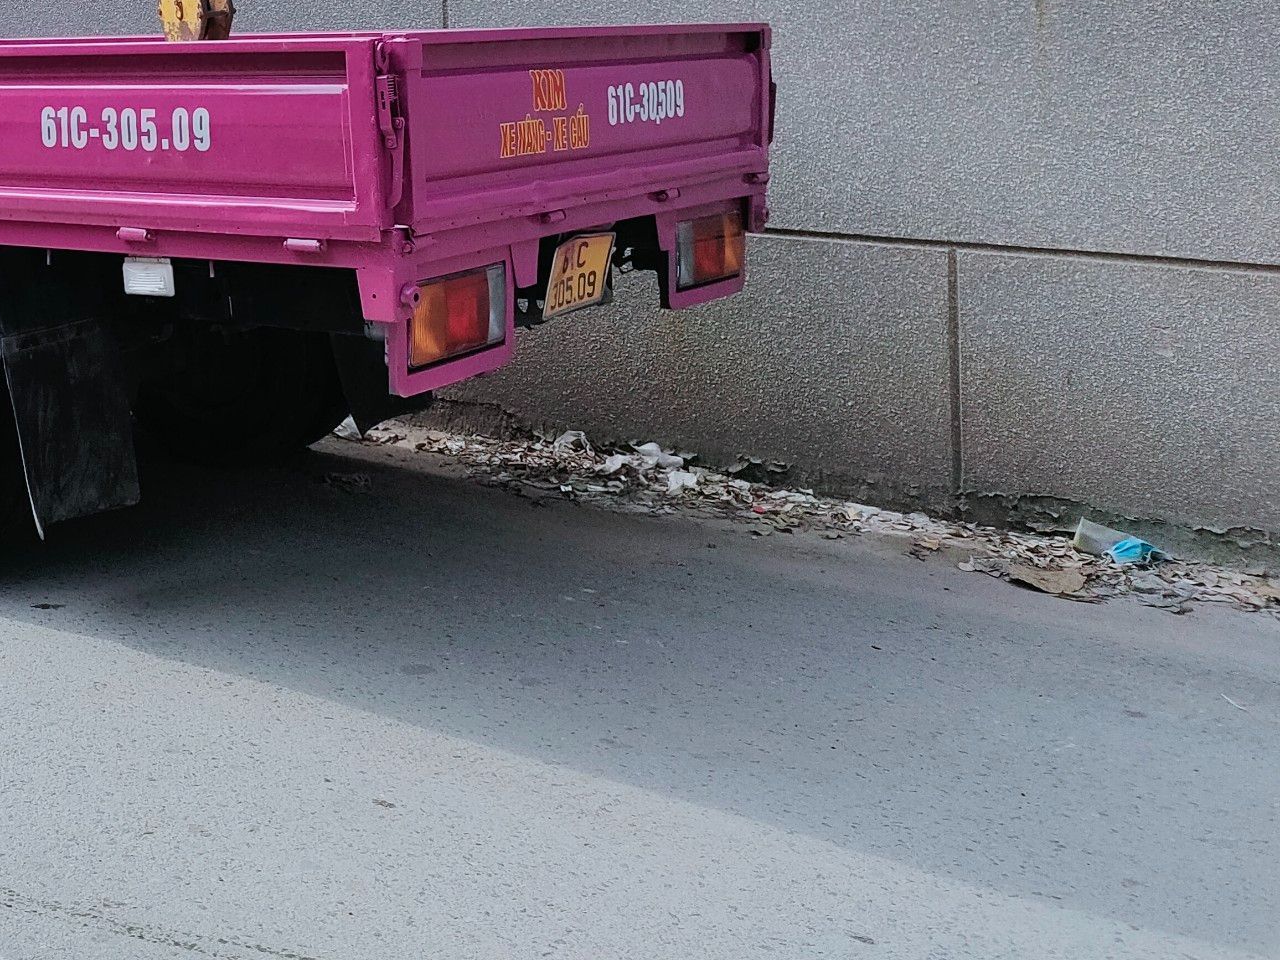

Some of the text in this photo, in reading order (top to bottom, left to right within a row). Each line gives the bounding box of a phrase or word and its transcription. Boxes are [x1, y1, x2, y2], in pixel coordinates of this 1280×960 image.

[530, 69, 567, 112] KIM
[41, 106, 211, 151] 61C-305.09
[500, 122, 516, 158] XE
[553, 117, 567, 151] XE
